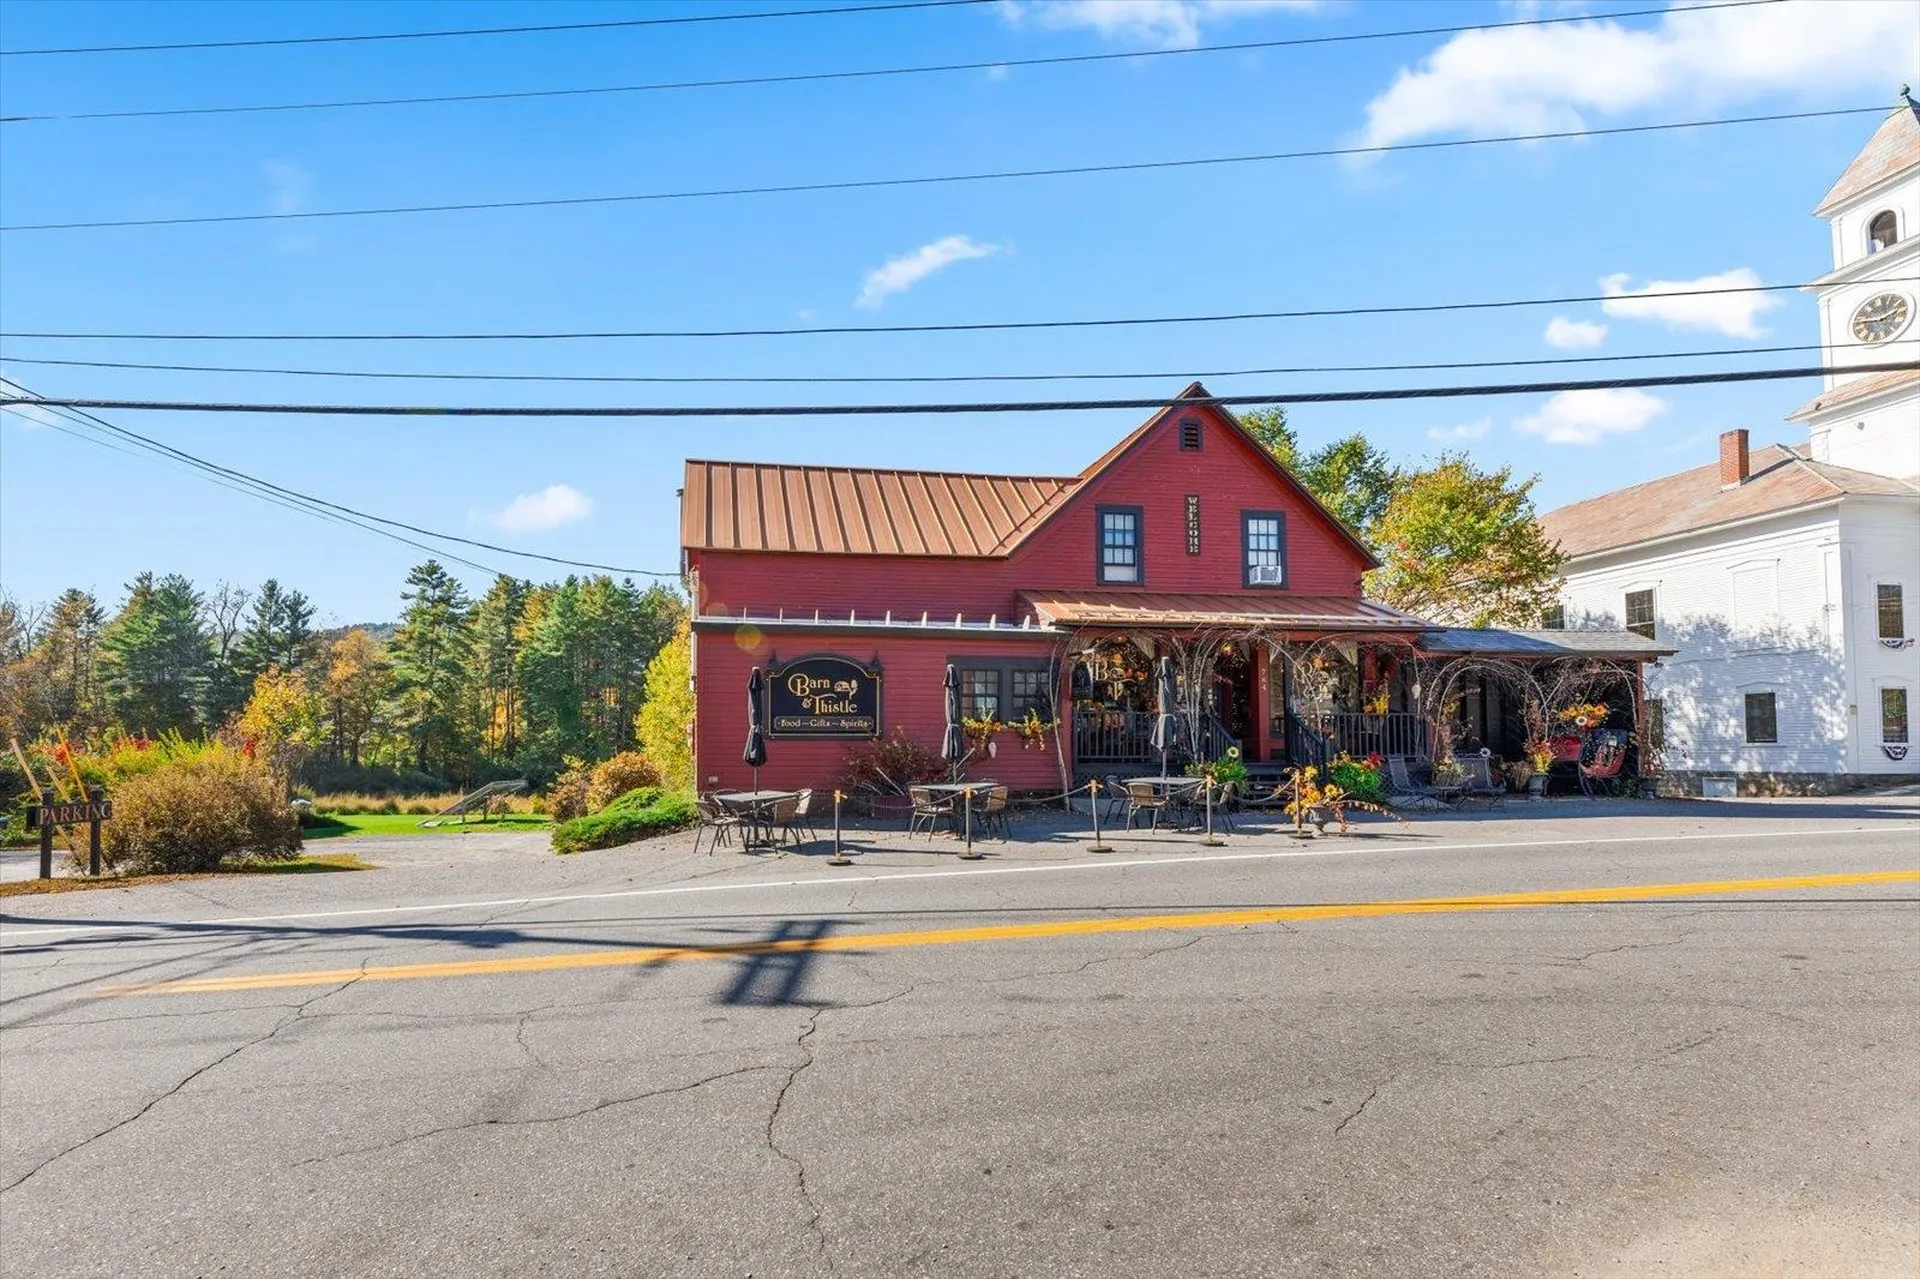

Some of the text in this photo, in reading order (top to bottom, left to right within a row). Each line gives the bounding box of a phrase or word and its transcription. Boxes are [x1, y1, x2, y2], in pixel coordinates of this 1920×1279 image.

[1188, 497, 1199, 553] WELCOME
[787, 673, 830, 696] Barn
[802, 693, 858, 715] & Thistle
[780, 719, 868, 729] Food Gifts Spirits
[39, 803, 110, 825] PARKING
